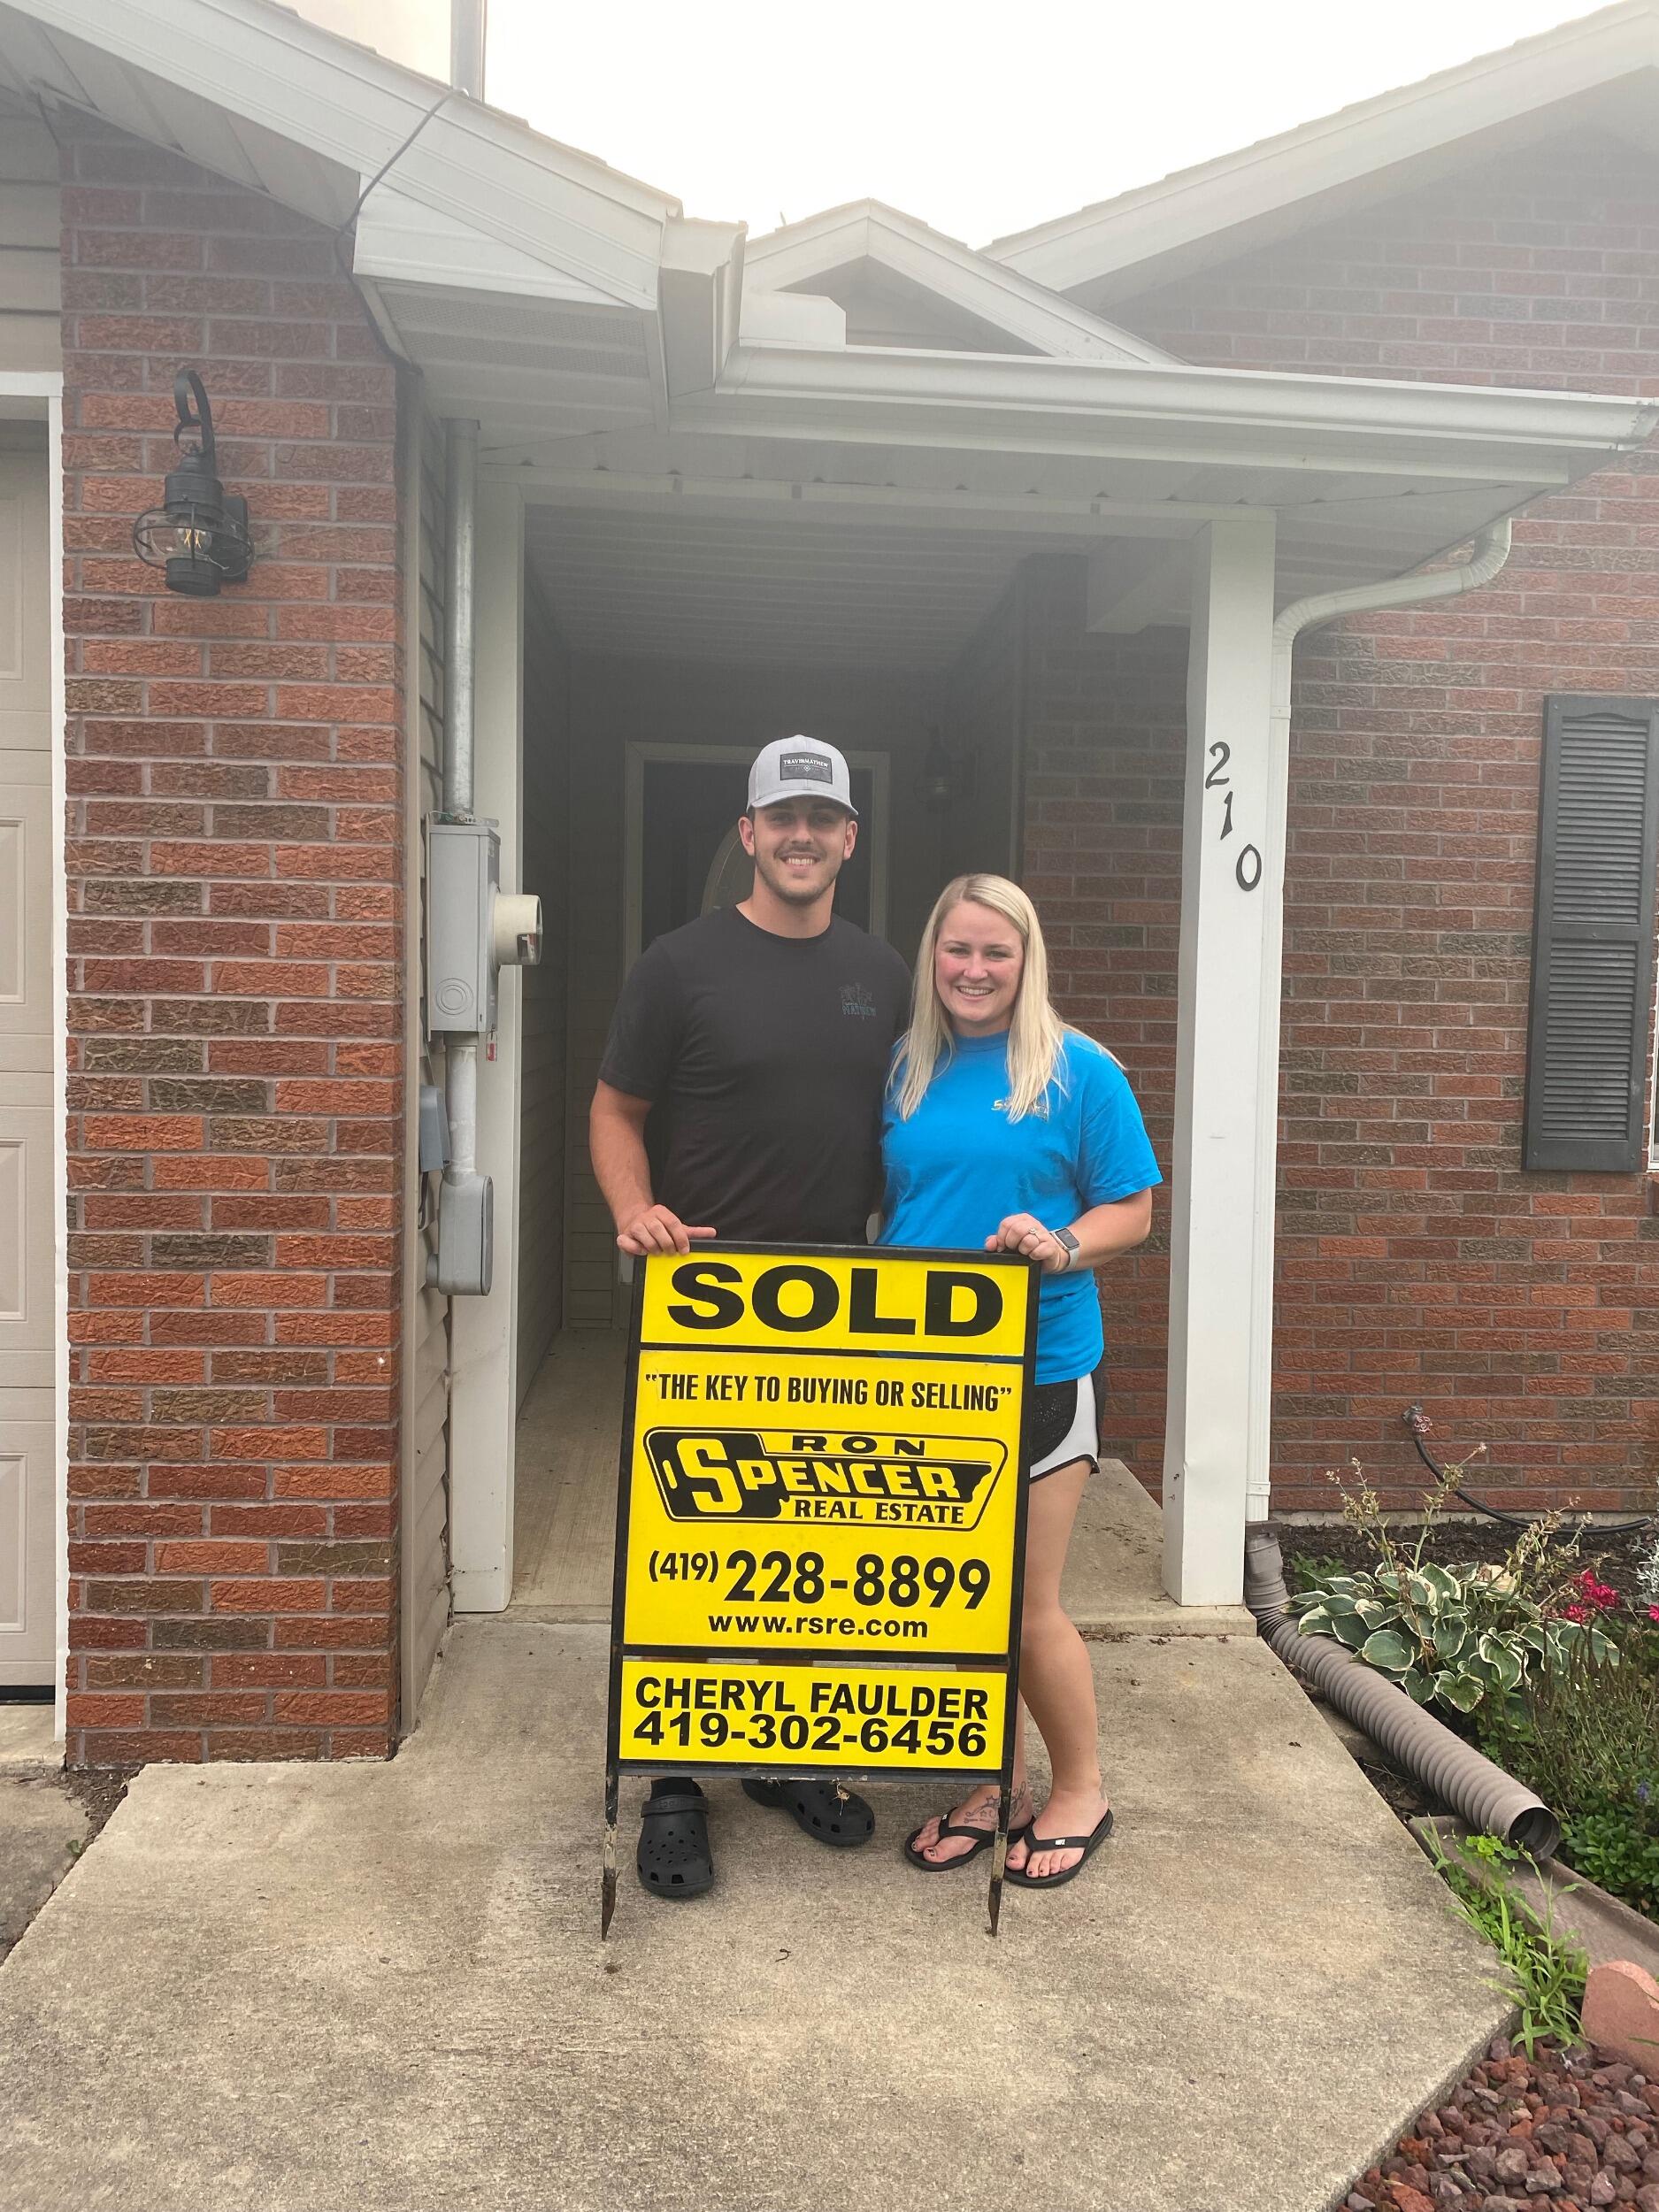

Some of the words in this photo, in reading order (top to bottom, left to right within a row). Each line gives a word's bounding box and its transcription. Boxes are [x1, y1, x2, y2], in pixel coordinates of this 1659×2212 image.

[668, 1262, 1003, 1337] SOLD
[645, 1373, 699, 1401] "THE
[705, 1374, 749, 1402] KEY
[754, 1376, 781, 1402] TO
[787, 1377, 868, 1405] BUYING
[875, 1379, 904, 1407] OR
[910, 1381, 1012, 1412] SELLING"
[791, 1434, 926, 1456] RON
[676, 1438, 961, 1514] SPENCER
[794, 1499, 864, 1520] REAL
[874, 1502, 964, 1525] ESTATE
[649, 1549, 719, 1584] (419)
[723, 1549, 991, 1610] 228-8899
[708, 1615, 929, 1638] www.rsre.com
[634, 1677, 795, 1712] CHERYL
[810, 1682, 988, 1720] FAULDER
[633, 1711, 988, 1757] 419-302-6456
